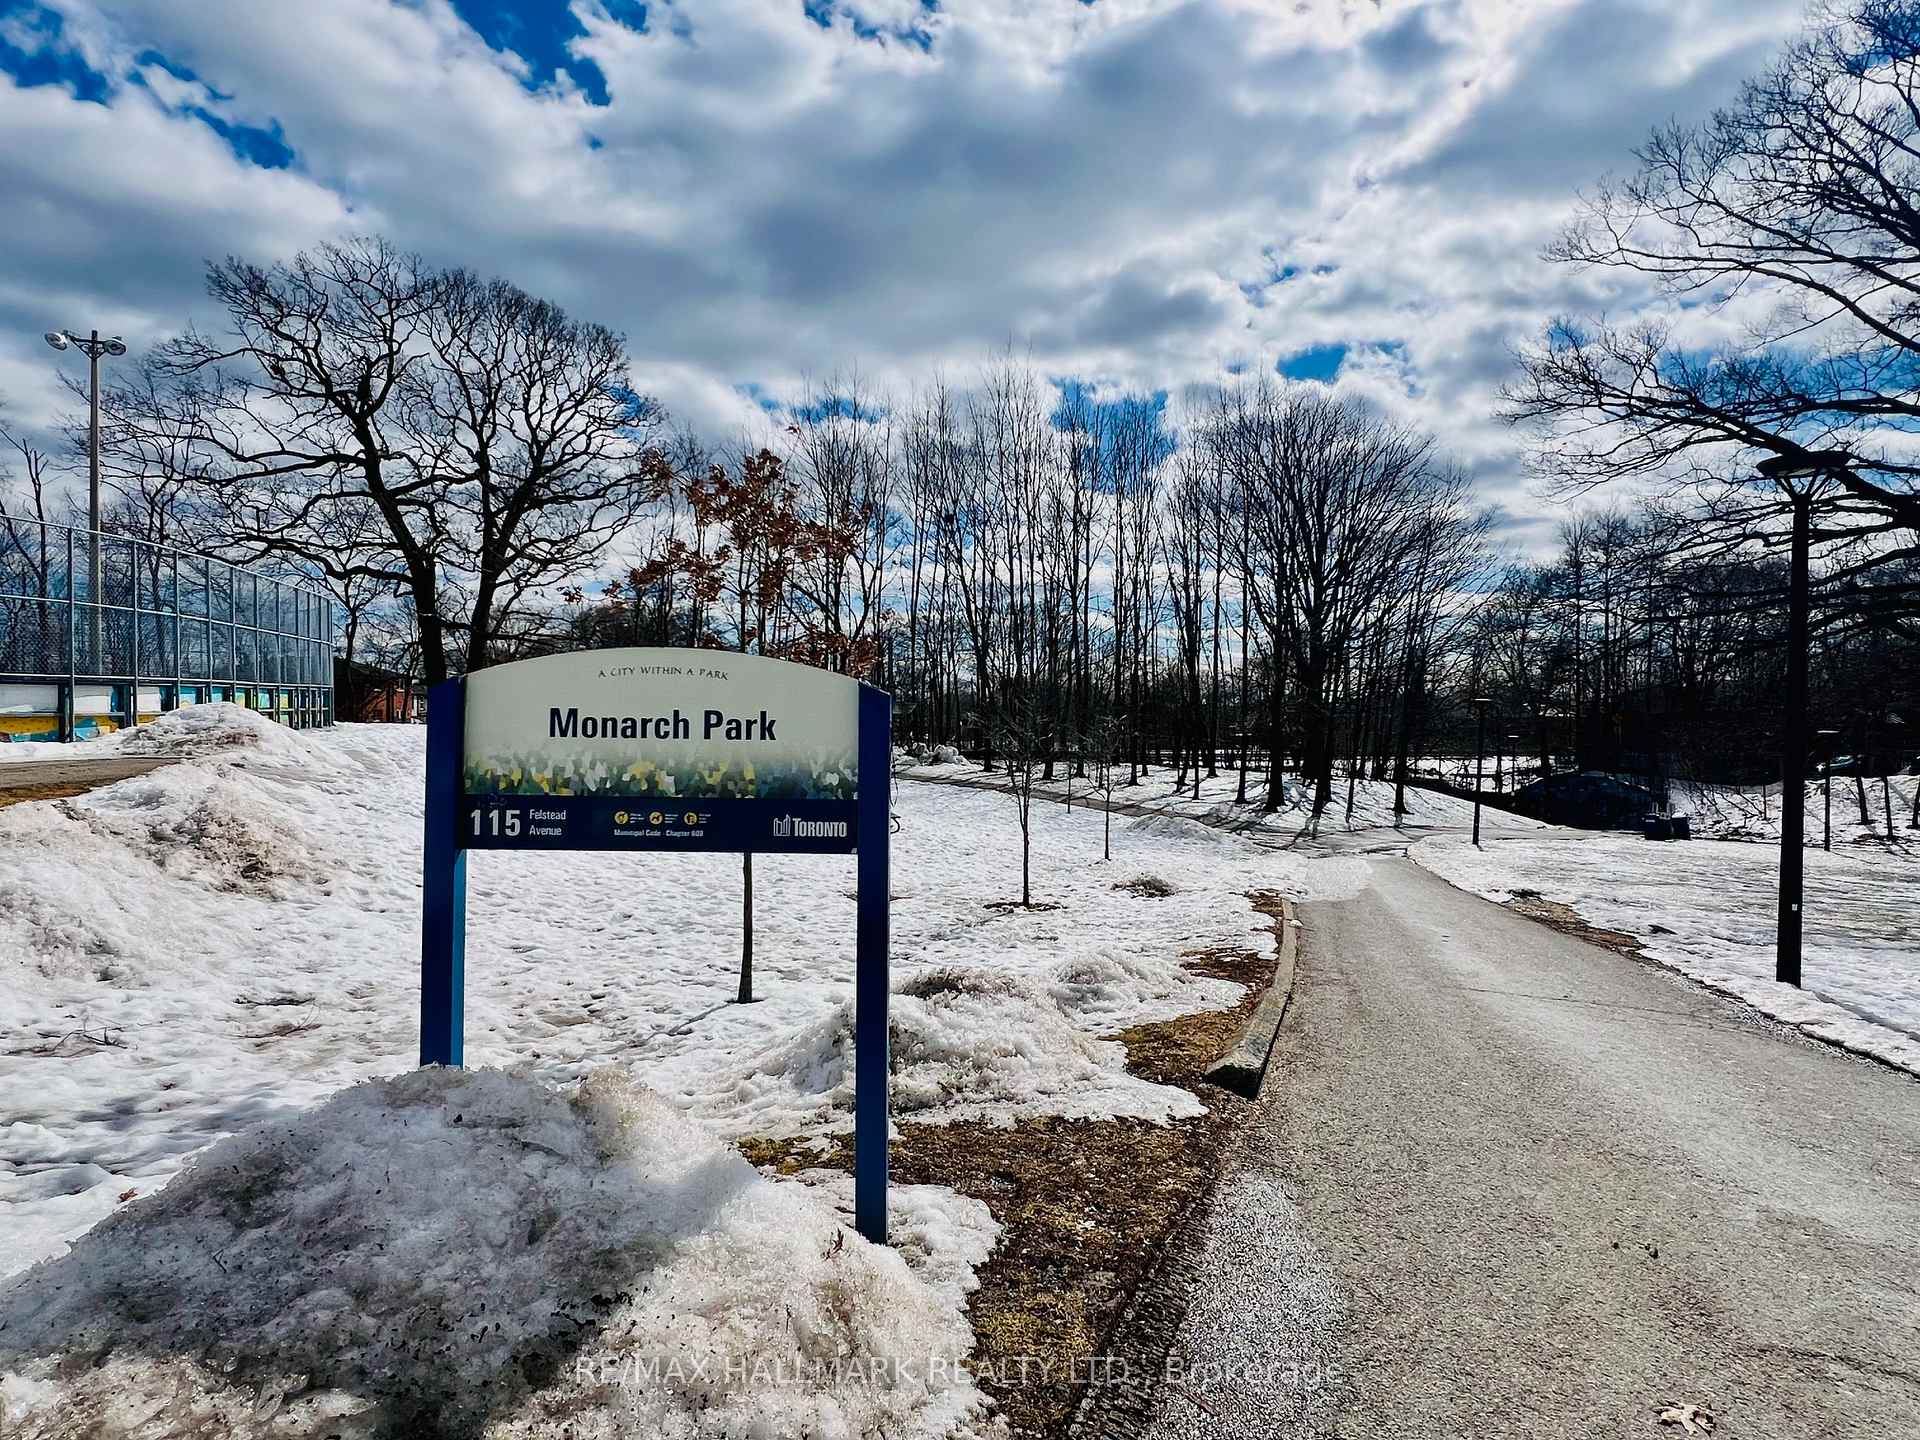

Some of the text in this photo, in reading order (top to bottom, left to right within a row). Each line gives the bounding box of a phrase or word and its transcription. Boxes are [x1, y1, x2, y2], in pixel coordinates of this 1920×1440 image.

[598, 666, 729, 681] A CITY WITHIN A PARK
[549, 707, 777, 741] Monarch Park
[529, 808, 567, 820] Felstead
[470, 809, 521, 837] 115
[529, 824, 563, 836] Avenue
[792, 817, 848, 837] TORONTO
